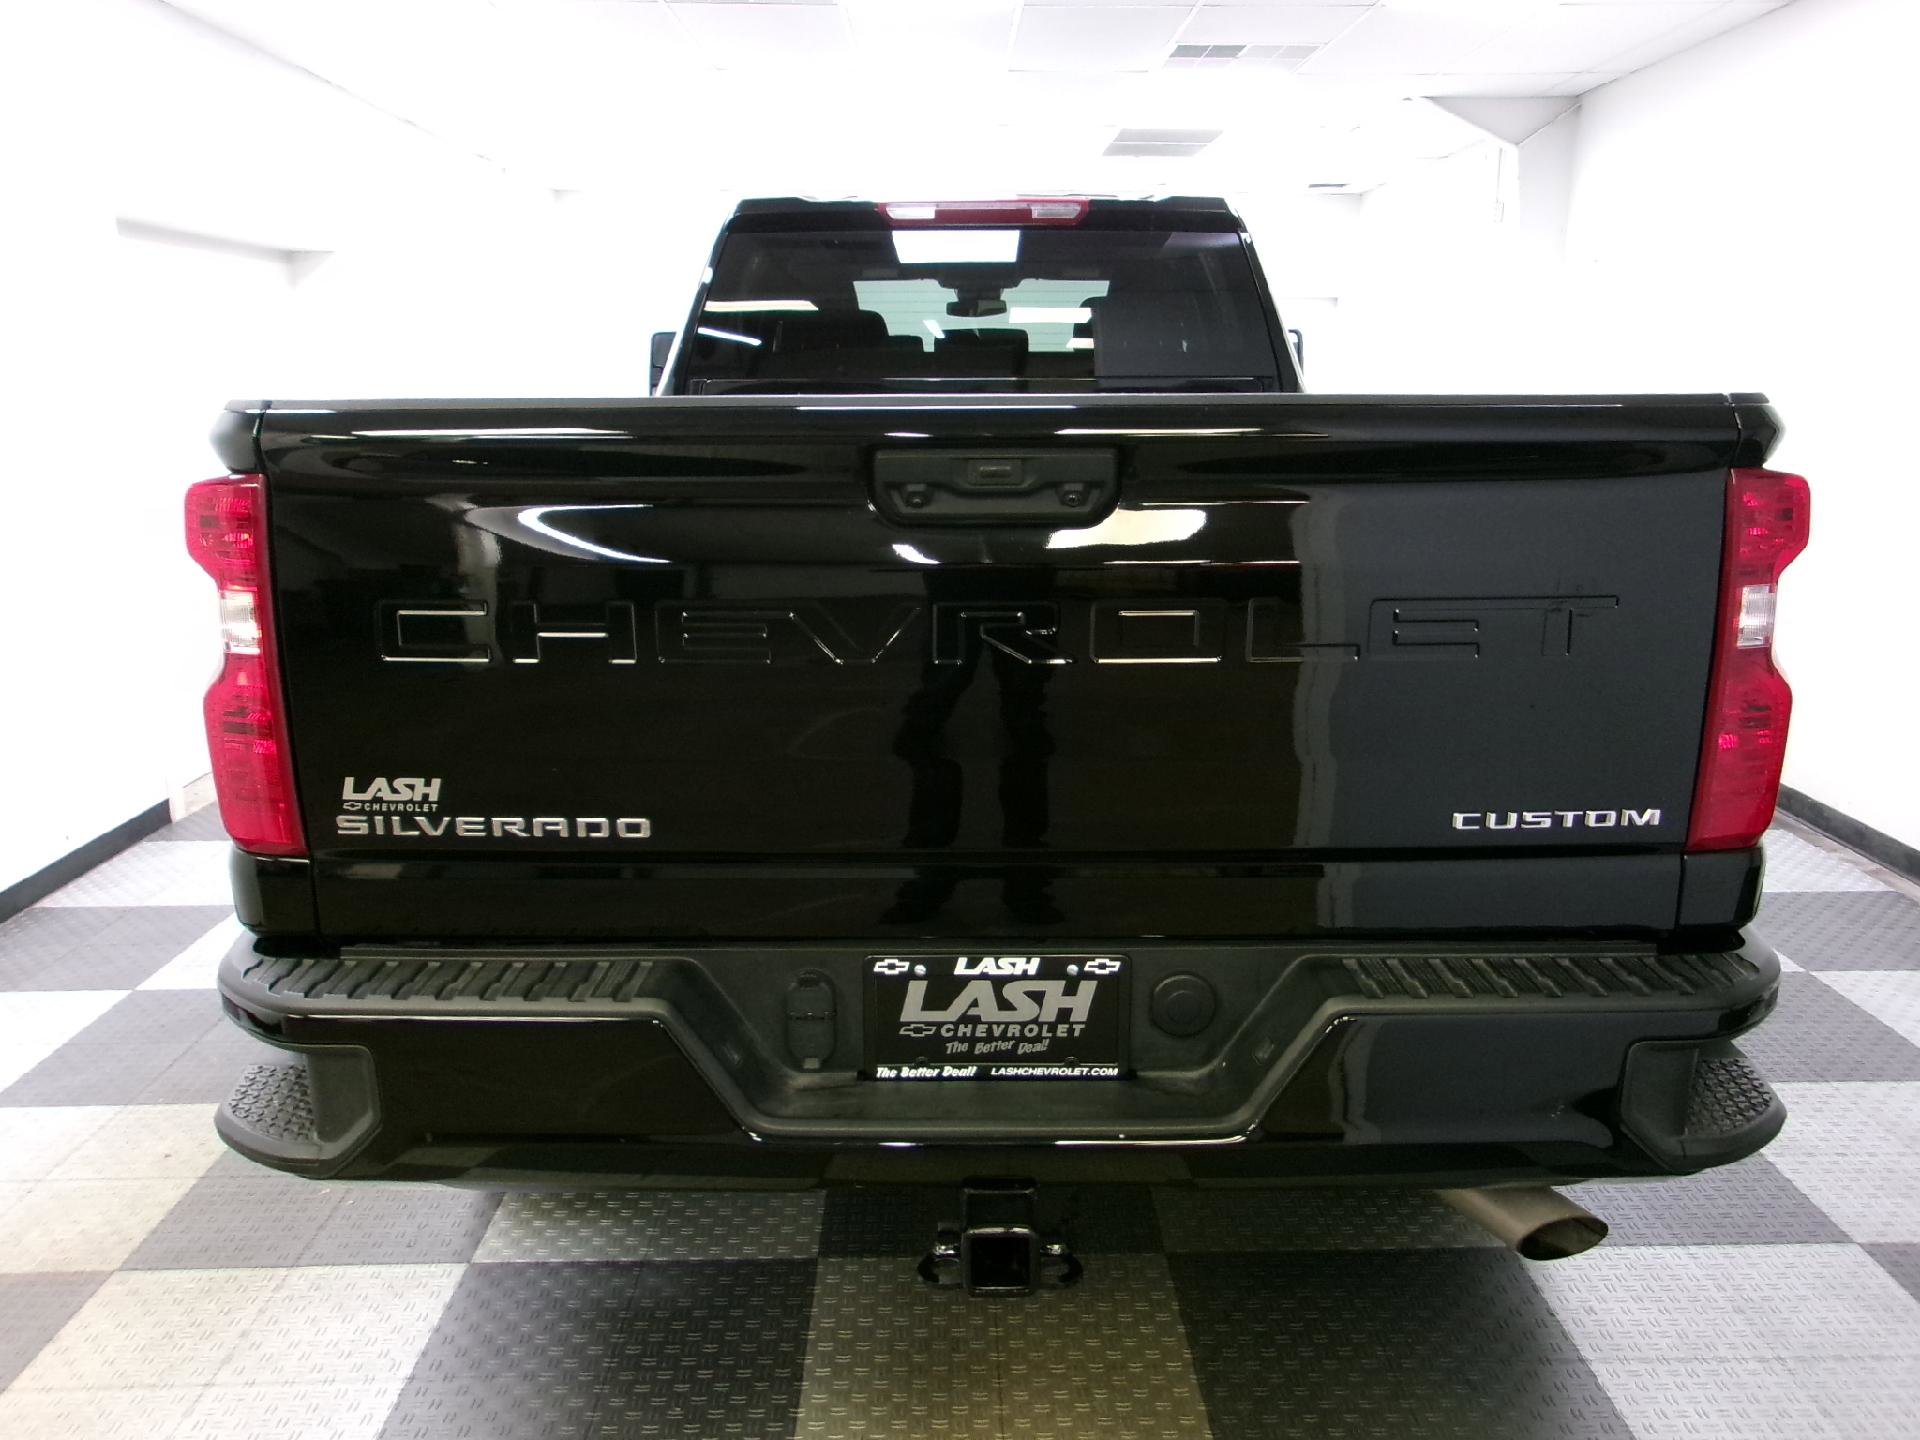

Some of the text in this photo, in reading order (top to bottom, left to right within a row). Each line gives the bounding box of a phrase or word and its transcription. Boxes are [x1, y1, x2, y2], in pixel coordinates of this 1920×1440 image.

[372, 596, 1619, 666] CHEVROLET
[342, 777, 441, 801] LASH
[364, 802, 438, 812] CHEVROLET
[336, 815, 651, 838] SILVERADO
[1452, 809, 1661, 830] CUSTOM
[953, 957, 1040, 975] LASH
[900, 980, 1098, 1022] LASH
[940, 1024, 1086, 1037] CHEVROLET
[945, 1039, 969, 1054] The
[974, 1040, 1016, 1054] Better
[876, 1066, 898, 1078] The
[901, 1066, 939, 1077] Better
[991, 1067, 1119, 1076] LASHCHEVROLET.COM
